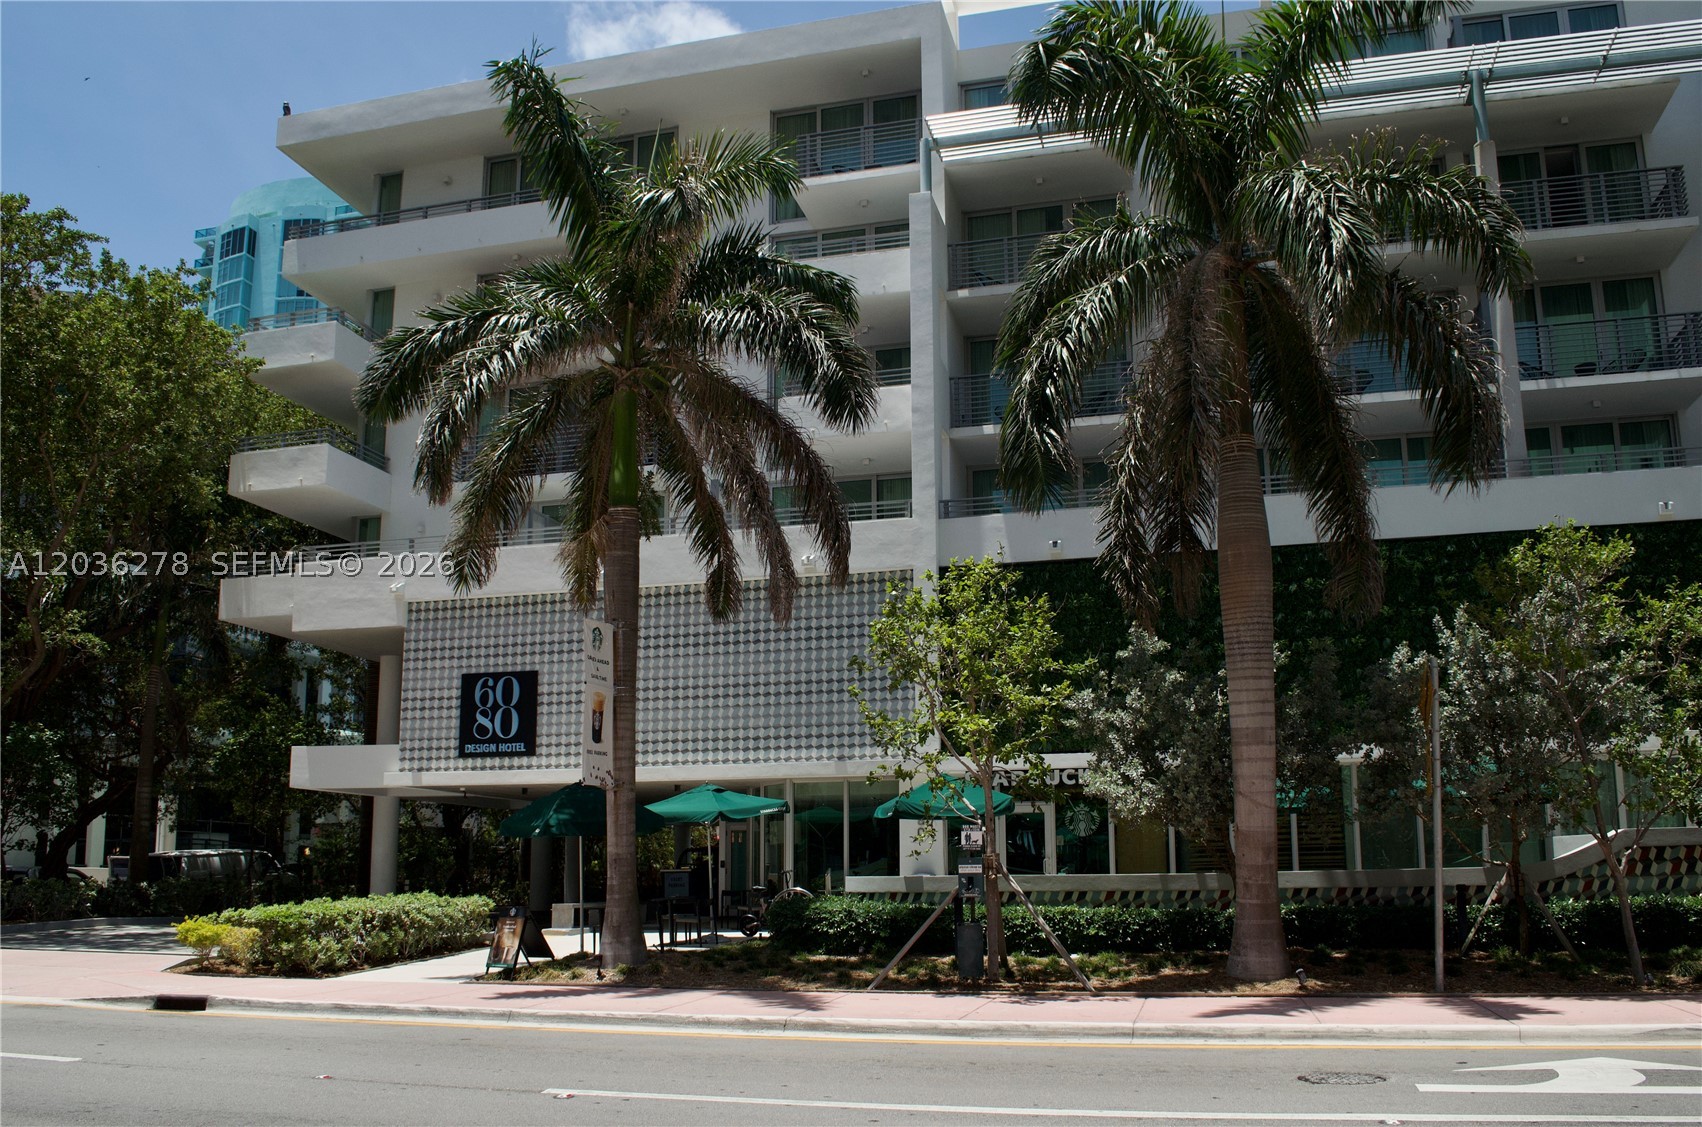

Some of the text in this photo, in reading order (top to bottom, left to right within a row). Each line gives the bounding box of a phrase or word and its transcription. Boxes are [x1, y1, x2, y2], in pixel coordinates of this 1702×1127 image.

[474, 675, 520, 708] 60
[473, 706, 519, 739] 80
[465, 742, 526, 753] DESIGN HOTEL
